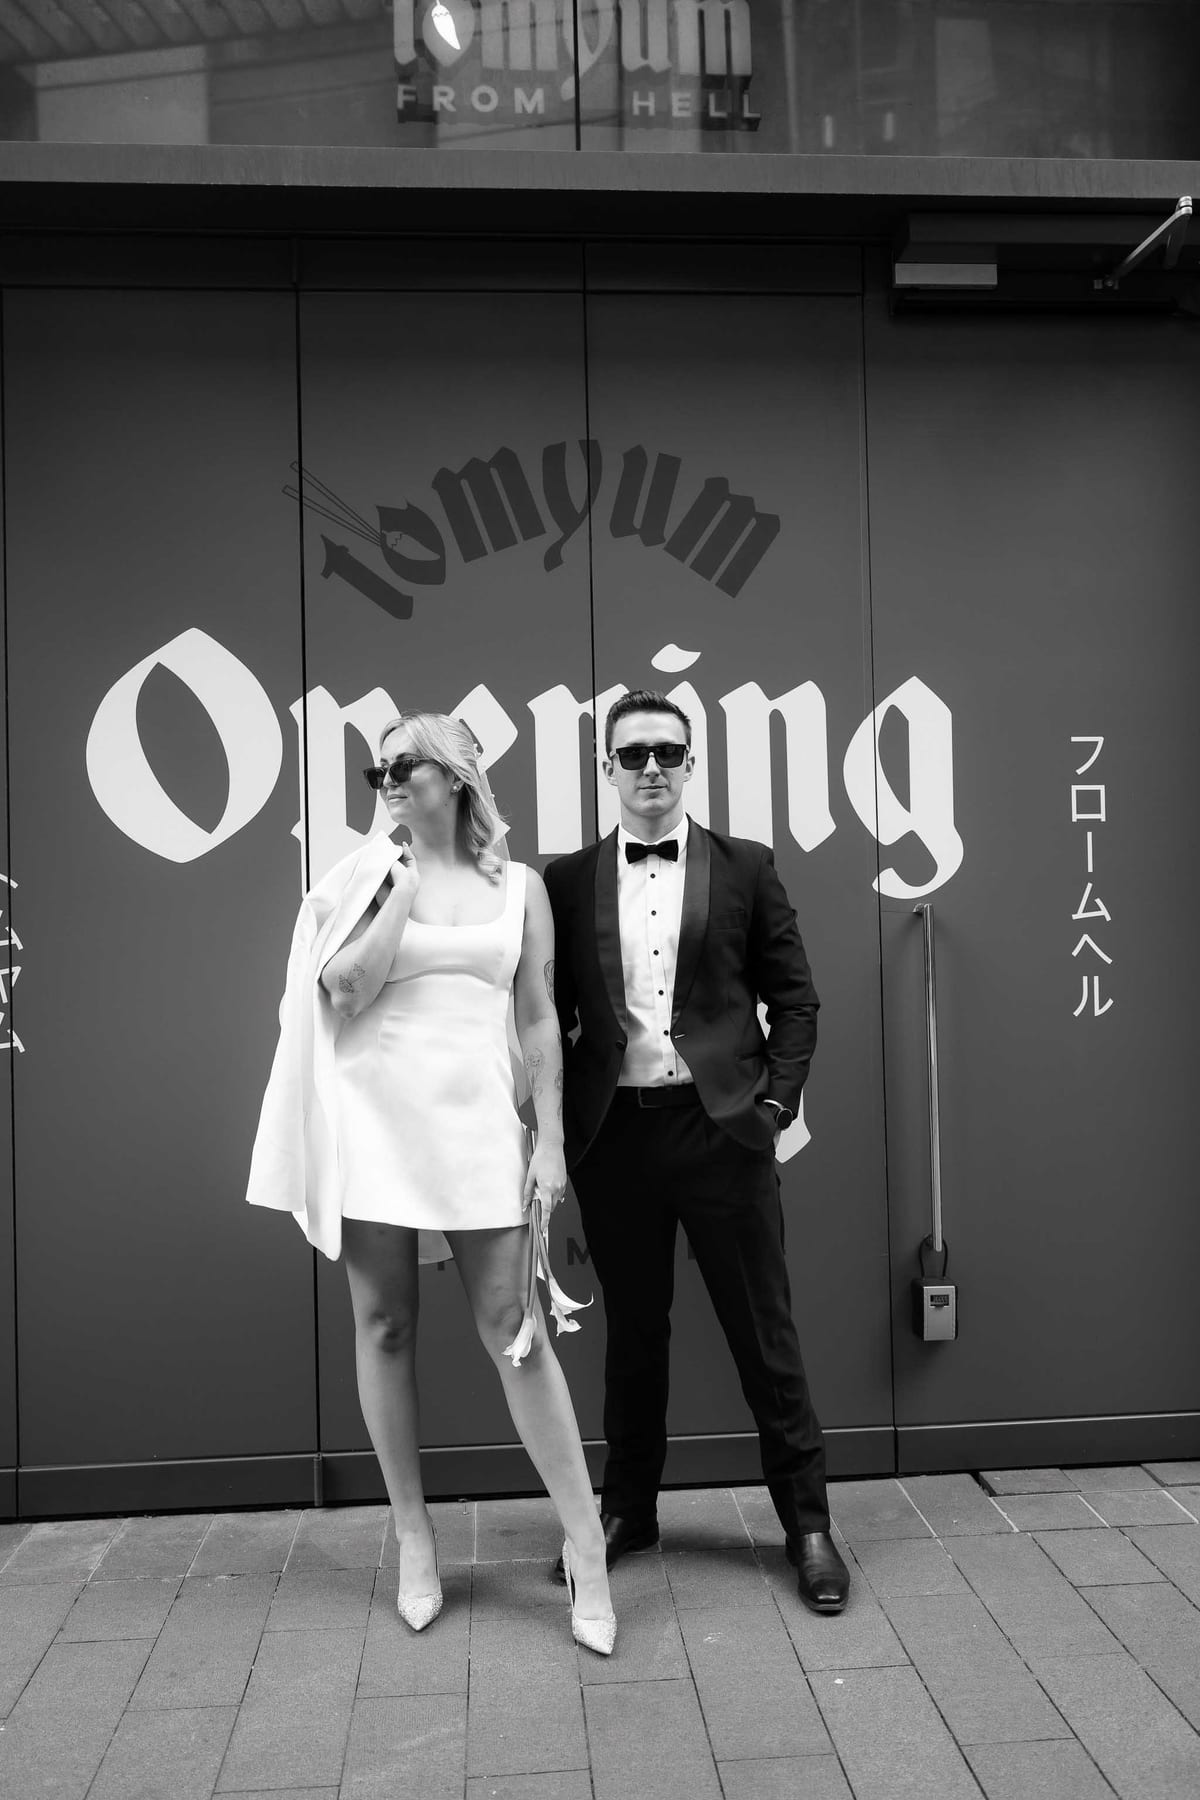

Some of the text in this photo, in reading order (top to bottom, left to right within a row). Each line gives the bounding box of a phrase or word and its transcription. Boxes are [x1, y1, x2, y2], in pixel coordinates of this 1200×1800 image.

[397, 85, 761, 118] FROM HELL
[320, 439, 781, 620] tomyum
[1070, 736, 1114, 1017] フロームヘル
